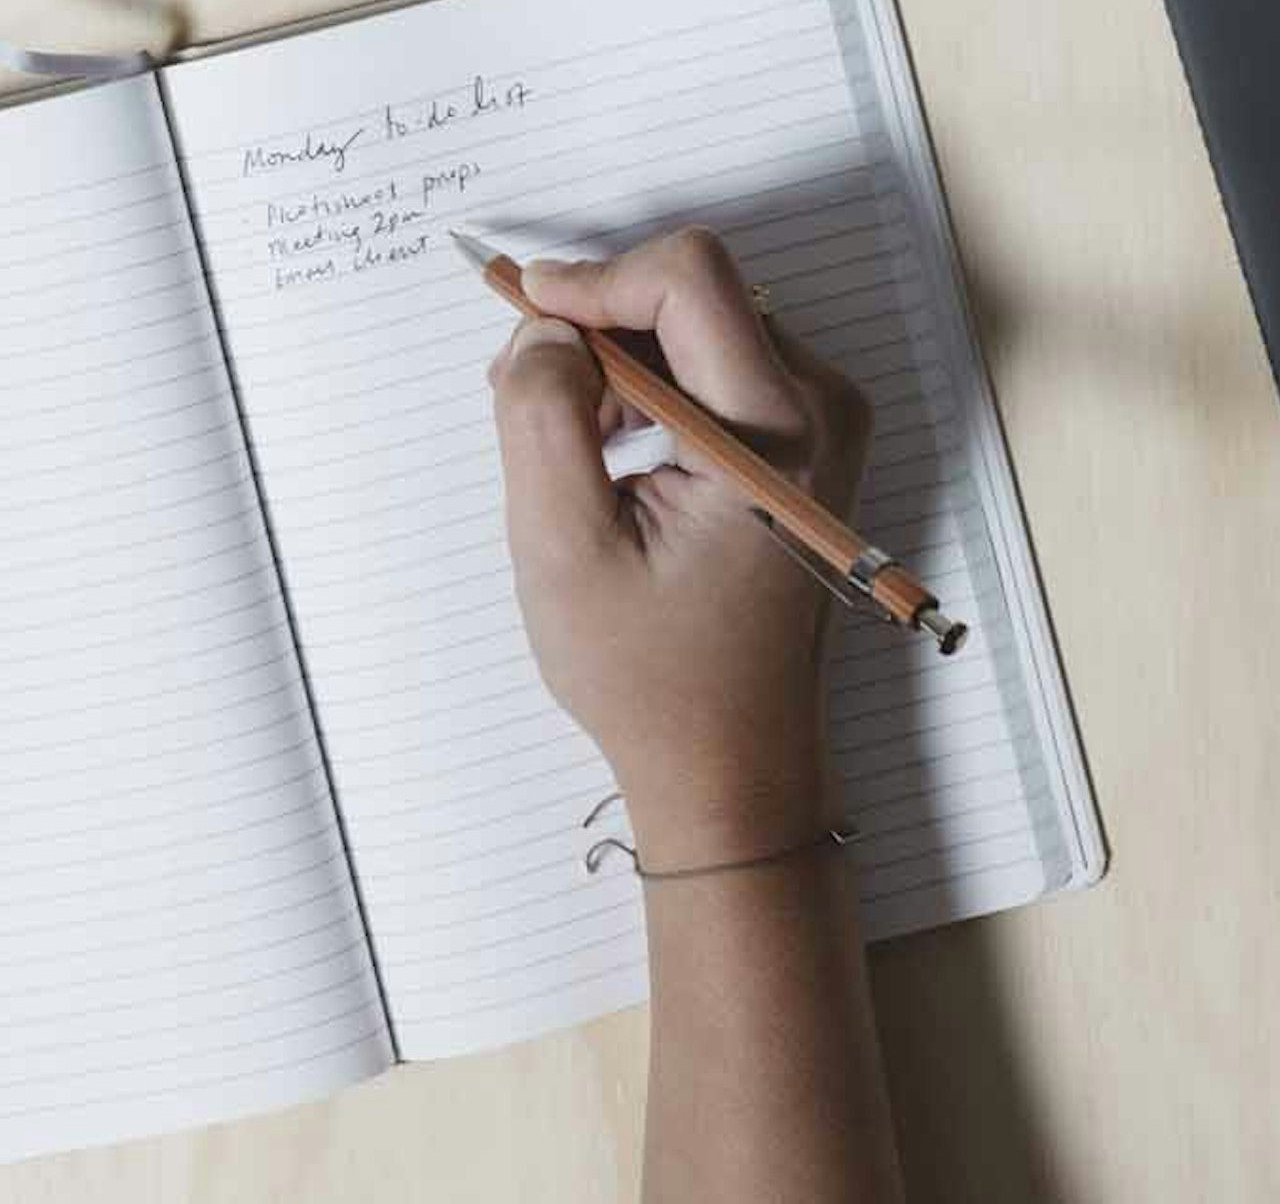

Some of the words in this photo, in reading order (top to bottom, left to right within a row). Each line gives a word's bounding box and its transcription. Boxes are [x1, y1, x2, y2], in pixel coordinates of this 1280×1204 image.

[242, 128, 365, 177] Monday
[471, 74, 534, 117] list
[268, 223, 362, 255] Meeting
[372, 210, 424, 235] 2pm
